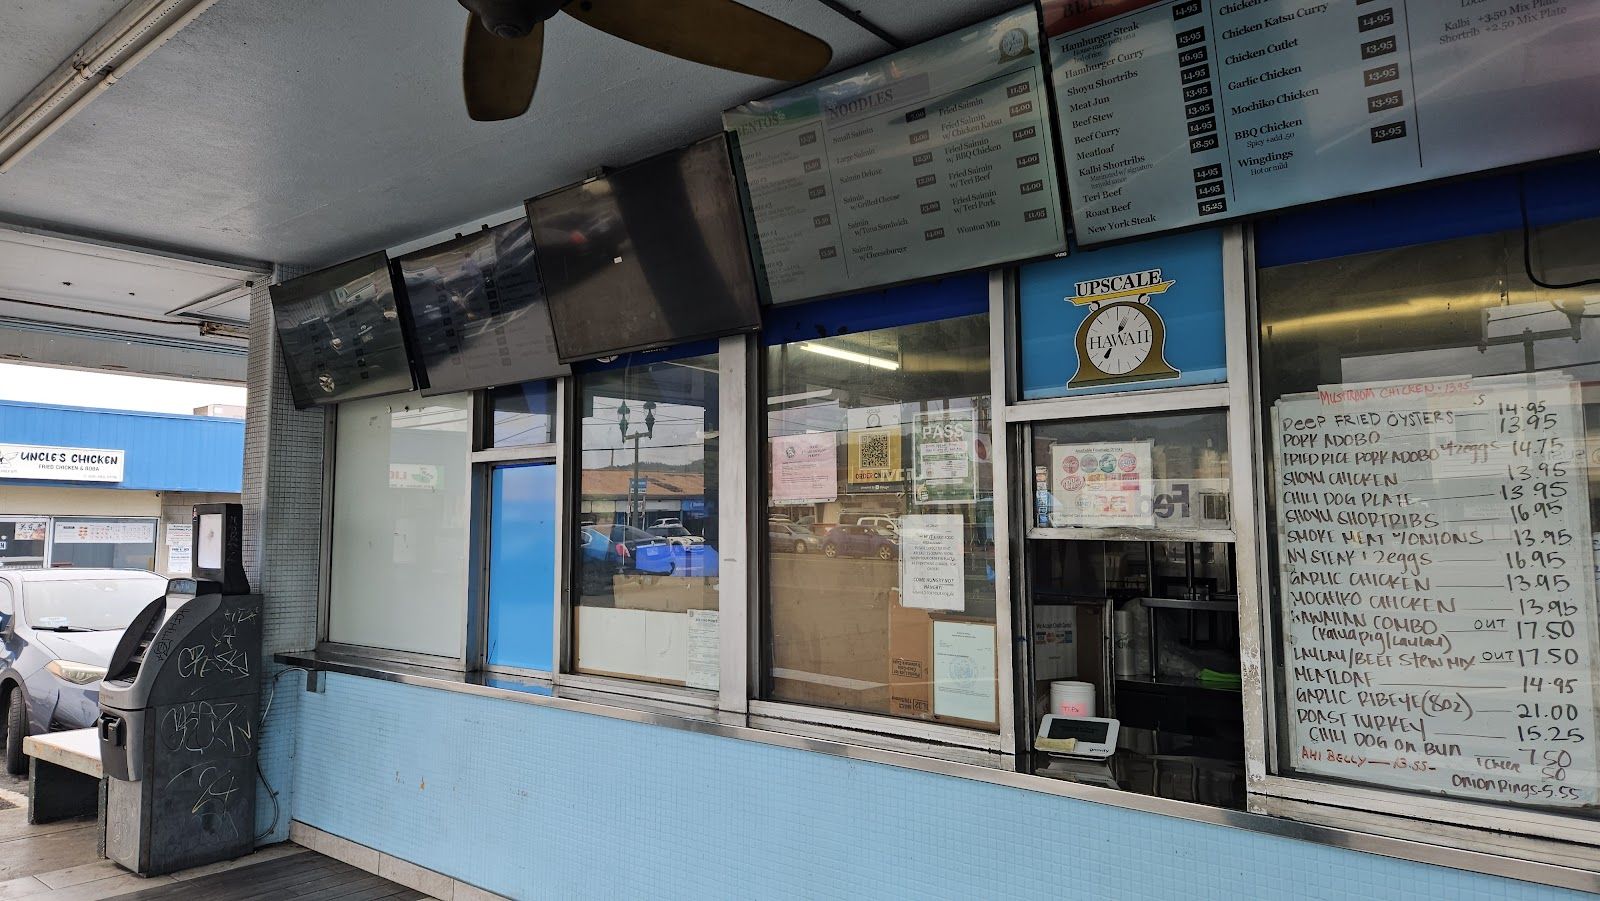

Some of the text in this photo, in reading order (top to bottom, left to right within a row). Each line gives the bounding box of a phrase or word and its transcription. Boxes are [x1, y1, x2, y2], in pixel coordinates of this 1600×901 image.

[1061, 4, 1199, 52] Hamburger Steak 14.95
[1222, 3, 1390, 40] Chicken Katsu Curry 14.95
[1439, 7, 1567, 45] Shortrib Mix Plate
[1444, 2, 1530, 32] Kalbi Mix
[1065, 32, 1202, 79] Hamburger Curry 13.95
[1225, 38, 1393, 66] Chicken Cutlet 13.95
[1067, 52, 1204, 97] Shoyu Shortribs 16.95
[1228, 65, 1396, 91] Garlic Chicken 13.95
[828, 89, 893, 119] NOODLES
[1070, 70, 1206, 113] Meat Jun 14.95
[1231, 88, 1399, 115] Mochiko Chicken 13.95
[939, 97, 983, 116] Fried Saimin
[1072, 87, 1208, 129] Beef Stew 13.95
[1074, 104, 1211, 145] Beef Curry 13.95
[1234, 118, 1401, 141] BBQ Chicken 13.95
[944, 129, 1033, 154] Fried Saimin 14.00
[972, 143, 1002, 156] Chicken
[1076, 121, 1213, 161] Meatloaf 14.95
[1247, 138, 1264, 150] Spicy
[1079, 139, 1215, 177] Kalbi Shortribs 18.50
[1237, 150, 1294, 169] Wingdings
[1250, 166, 1264, 176] Hot
[948, 163, 993, 181] Fried Saimin
[960, 172, 991, 187] Teri Beef
[952, 189, 997, 206] Fried Saimin
[1083, 168, 1219, 203] Teri Beef 14.95
[978, 198, 996, 208] Pork
[1086, 185, 1221, 219] Roast Beef 14.95
[956, 219, 1001, 234] Wonton Min
[1088, 202, 1223, 235] New York Steak 15.25
[1076, 270, 1161, 297] UPSCALE
[1090, 330, 1150, 350] HAWAII
[1379, 383, 1435, 400] CHICKEN
[1334, 400, 1546, 427] FRIED OYSTERS 14.95
[922, 424, 963, 440] PASS
[1283, 413, 1557, 448] PORK ADOBO 13.95
[20, 451, 118, 465] UNCLE'S CHICKEN
[1283, 452, 1319, 467] FRIED
[1322, 452, 1352, 466] RICE
[1355, 451, 1388, 465] PORK
[1391, 449, 1439, 464] ADOBO
[1513, 437, 1563, 457] 14.75
[855, 472, 874, 481] ORDER
[1283, 461, 1570, 487] SHOYU CHICKEN 13.95
[1283, 482, 1569, 507] CHILI DOG PLATE 13.95
[1286, 500, 1562, 529] SHOYU SHORTRIBS 16.95
[1287, 529, 1334, 544] SMOKE
[1342, 530, 1385, 547] MEAT
[1514, 529, 1572, 547] 13.95
[1287, 549, 1307, 565] NY
[1311, 550, 1355, 566] STEAK
[1506, 550, 1566, 569] 16.95
[1290, 571, 1570, 592] GARLIC CHICKEN 13.95
[1290, 591, 1577, 617] MOCHIKO CHICKEN 13.95
[1373, 616, 1437, 635] COMBO
[1474, 618, 1506, 631] OUT
[1517, 620, 1574, 639] 17.50
[1482, 650, 1514, 662] OUT
[1518, 648, 1579, 667] 17.50
[1294, 665, 1578, 694] MEATLOAF 14.95
[1296, 687, 1578, 721] GARLIC 21.00
[1297, 708, 1585, 743] ROAST TURKEY 15.25
[1309, 726, 1347, 745] CHILI
[1353, 732, 1388, 749] DOG
[1301, 745, 1367, 768] AHI BELLY
